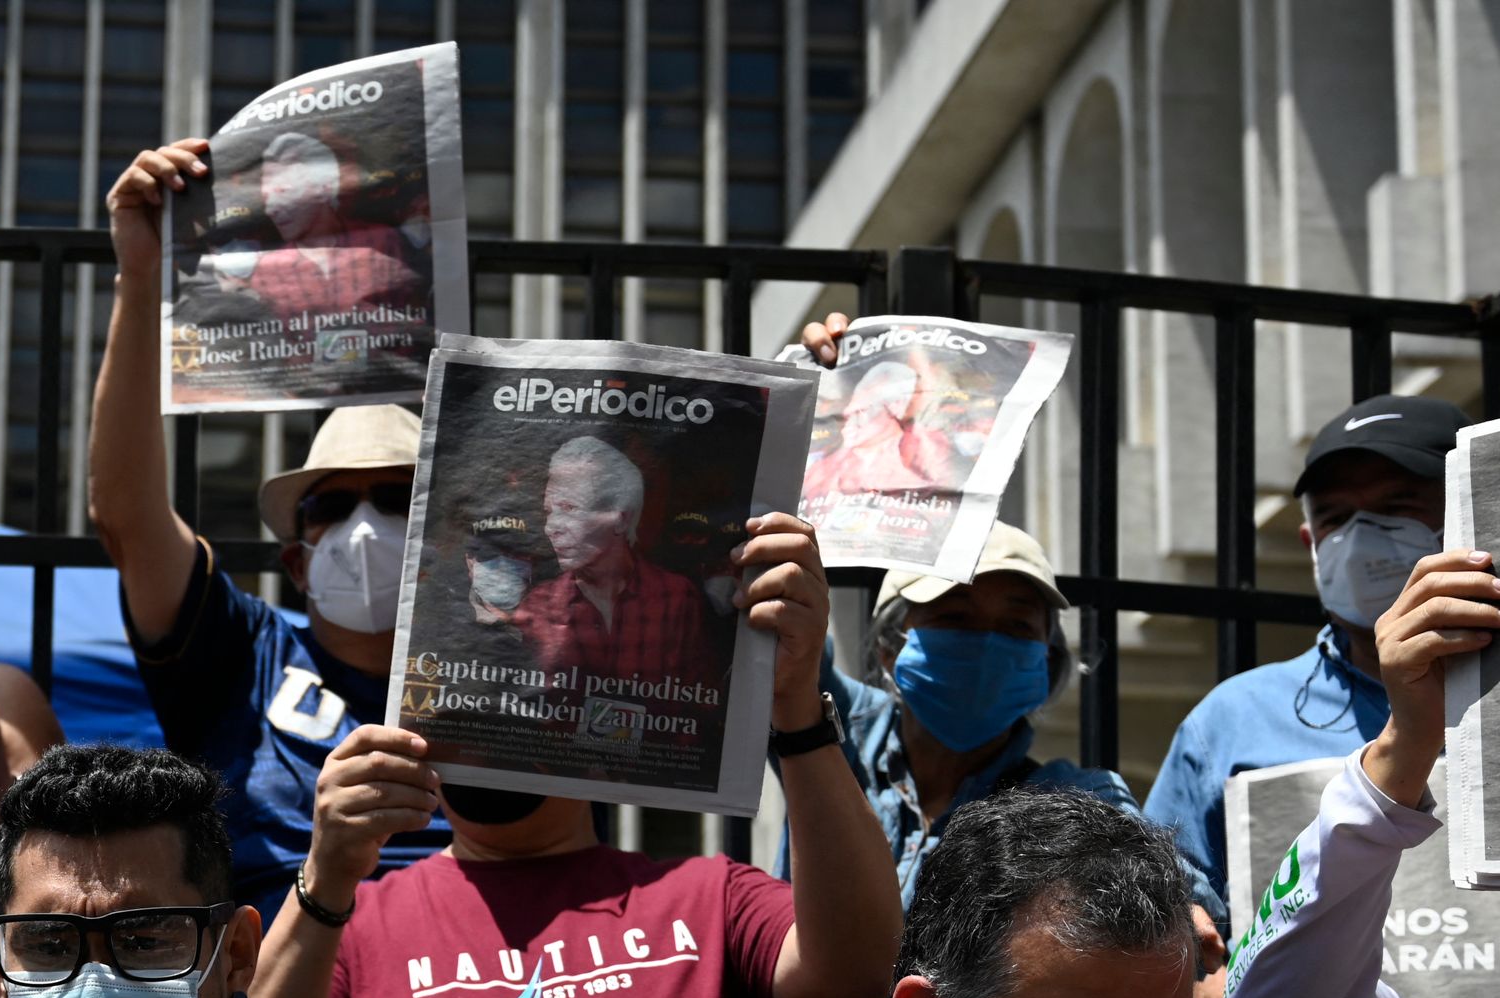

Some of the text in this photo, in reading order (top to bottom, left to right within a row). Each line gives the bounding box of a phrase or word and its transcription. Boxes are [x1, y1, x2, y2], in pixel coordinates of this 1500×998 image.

[180, 303, 427, 345] Capturan al periodista
[195, 346, 243, 366] Jose
[250, 335, 318, 362] Rubén
[416, 651, 719, 706] Capturan al periodista
[429, 684, 698, 736] Jose Rubén Zamora
[1280, 888, 1310, 924] INC.
[1382, 907, 1468, 937] NOS
[407, 918, 697, 990] NAUTICA
[583, 972, 633, 997] 1983
